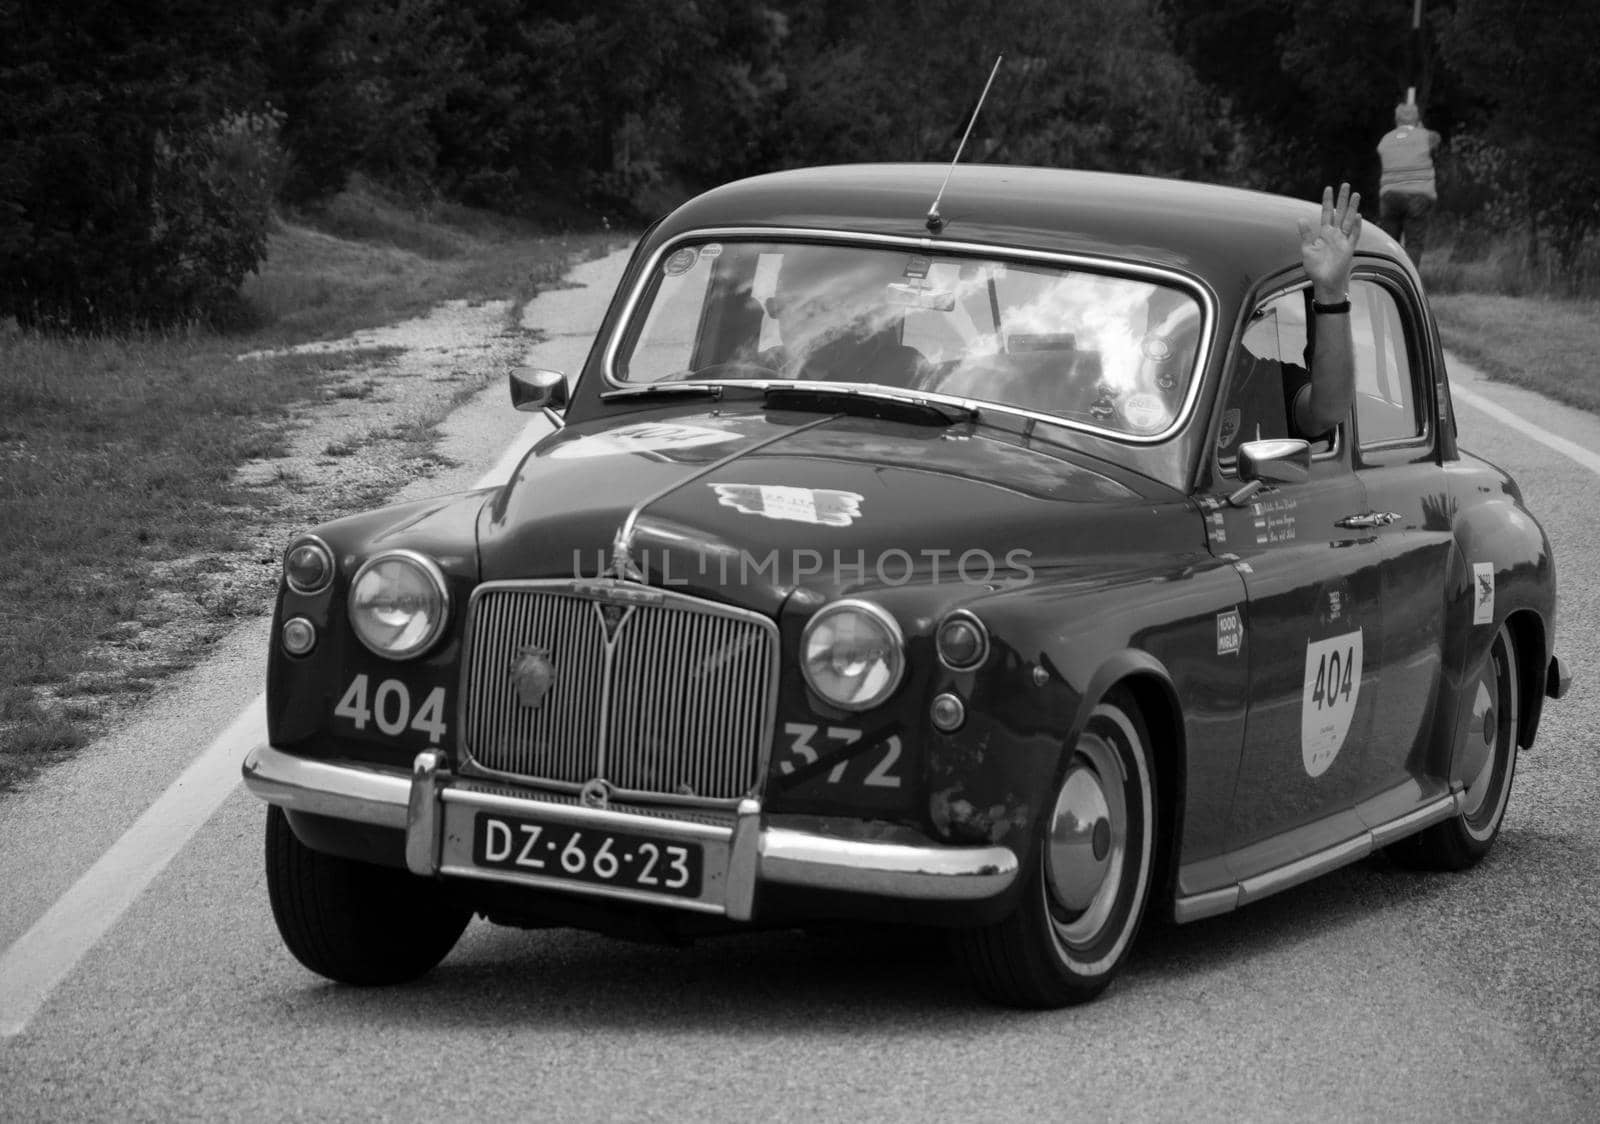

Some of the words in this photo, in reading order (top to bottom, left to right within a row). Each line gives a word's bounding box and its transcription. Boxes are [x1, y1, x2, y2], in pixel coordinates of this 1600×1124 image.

[1220, 615, 1237, 632] 1000
[334, 674, 447, 743] 404
[1312, 646, 1354, 711] 404
[780, 722, 902, 788] 372
